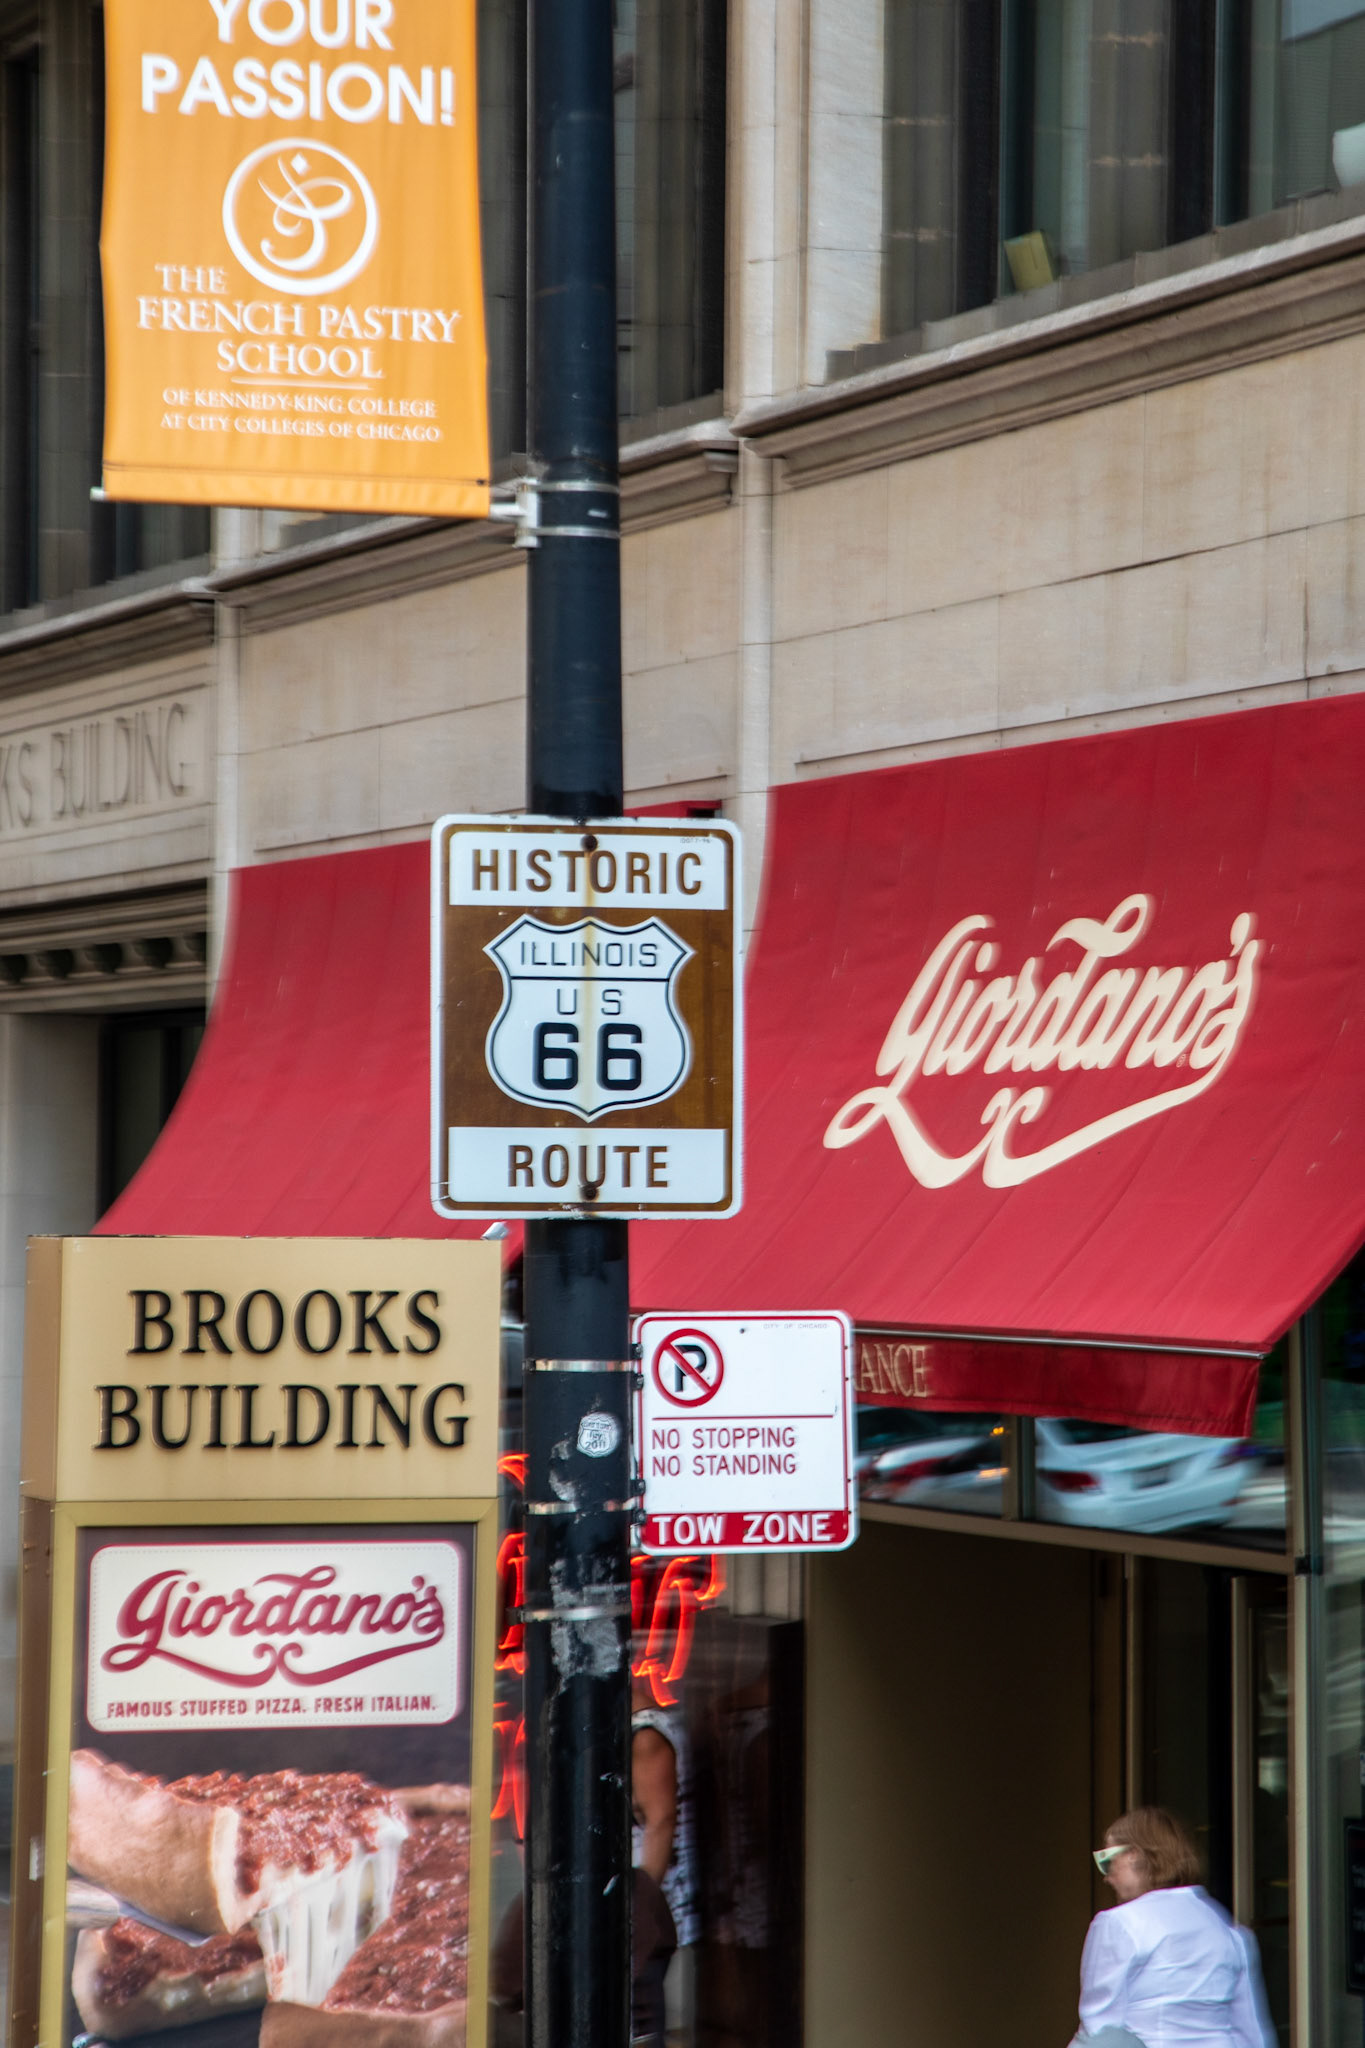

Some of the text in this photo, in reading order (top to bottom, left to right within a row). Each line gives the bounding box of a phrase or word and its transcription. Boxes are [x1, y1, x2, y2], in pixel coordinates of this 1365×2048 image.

[207, 0, 395, 51] YOUR
[140, 53, 456, 127] PASSION!
[155, 264, 229, 295] THE
[136, 296, 463, 344] FRENCH PASTRY
[216, 339, 386, 380] SCHOOL
[162, 387, 439, 419] OF KENNEDY-KING COLLEGE
[160, 413, 444, 444] AT CITY COLLEGES OF CHICAGO
[51, 702, 187, 820] BUILDING
[471, 848, 704, 896] HISTORIC
[519, 941, 659, 968] ILLINOIS
[533, 1022, 643, 1091] 66
[823, 893, 1265, 1189] Giordano's
[507, 1144, 669, 1189] ROUTE
[126, 1288, 443, 1357] BROOKS
[92, 1381, 470, 1451] BUILDING
[652, 1426, 797, 1450] NO STOPPING
[652, 1454, 798, 1477] NO STANDING
[652, 1513, 833, 1545] TOW ZONE
[100, 1565, 446, 1688] Giordano's
[107, 1695, 437, 1718] FAMOUS STUFFED PIZZA. FRESH ITALIAN.
